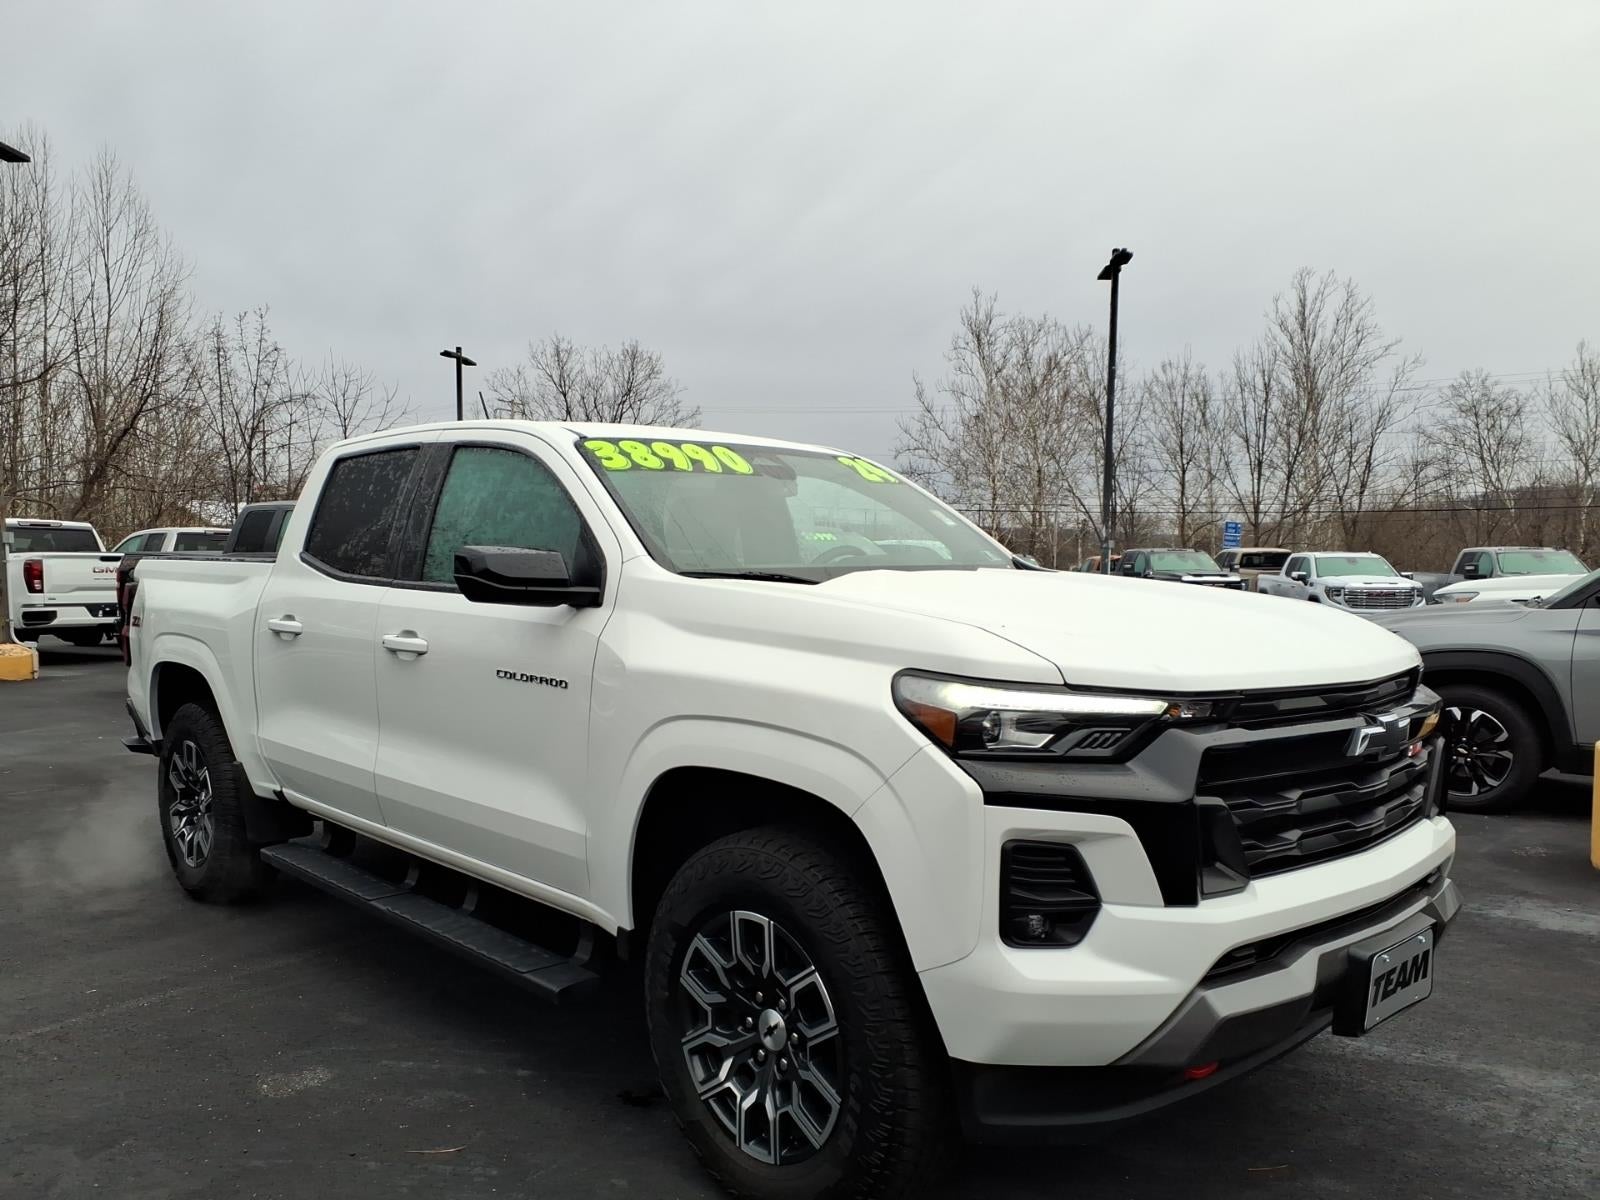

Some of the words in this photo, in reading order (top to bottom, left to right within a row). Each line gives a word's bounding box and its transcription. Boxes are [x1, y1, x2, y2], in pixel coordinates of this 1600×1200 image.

[584, 440, 753, 474] 38990
[496, 669, 569, 689] COLORADO
[1371, 948, 1430, 1008] TEAM
